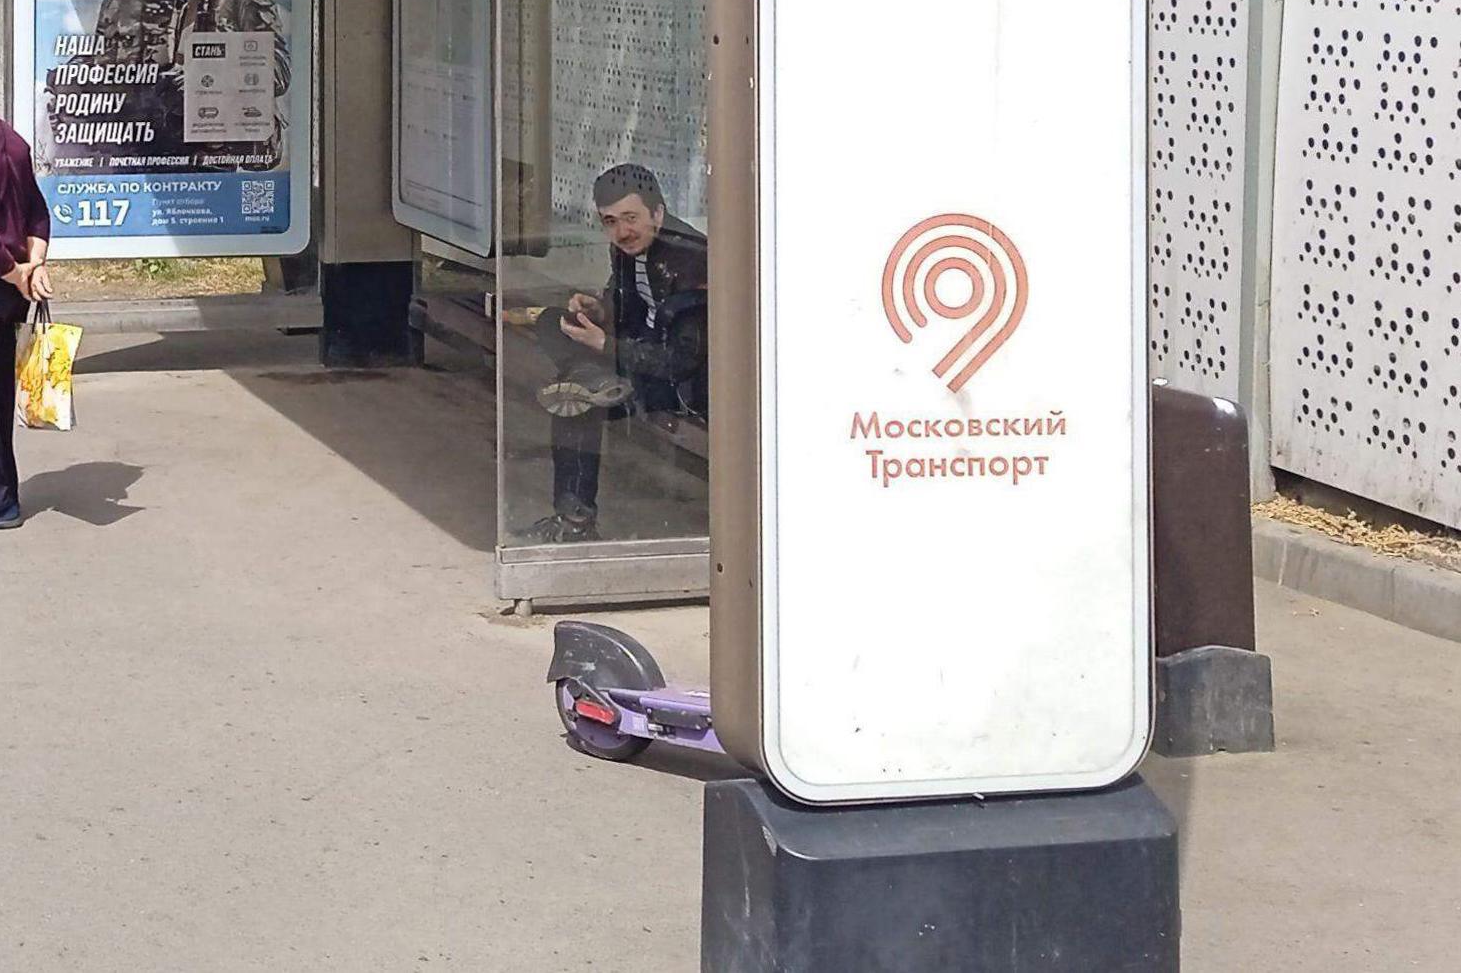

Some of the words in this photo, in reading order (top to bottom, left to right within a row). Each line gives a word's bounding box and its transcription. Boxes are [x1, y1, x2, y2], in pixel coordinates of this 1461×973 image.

[54, 35, 106, 56] НАША
[54, 63, 160, 86] ПРОФЕССИЯ
[54, 93, 127, 117] РОДИНУ
[54, 121, 156, 146] ЗАЩИЩАТЬ
[55, 157, 95, 167] УВАЖЕНИЕ
[146, 155, 190, 166] ПРОФЕССИЯ
[202, 154, 244, 166] ДОСТОЙНАЯ
[57, 182, 117, 195] СЛУЖБА
[120, 182, 140, 194] ПО
[143, 180, 222, 194] КОНТРАКТУ
[77, 199, 130, 227] 117
[849, 410, 1068, 440] Московский
[865, 449, 1050, 488] Транспорт
